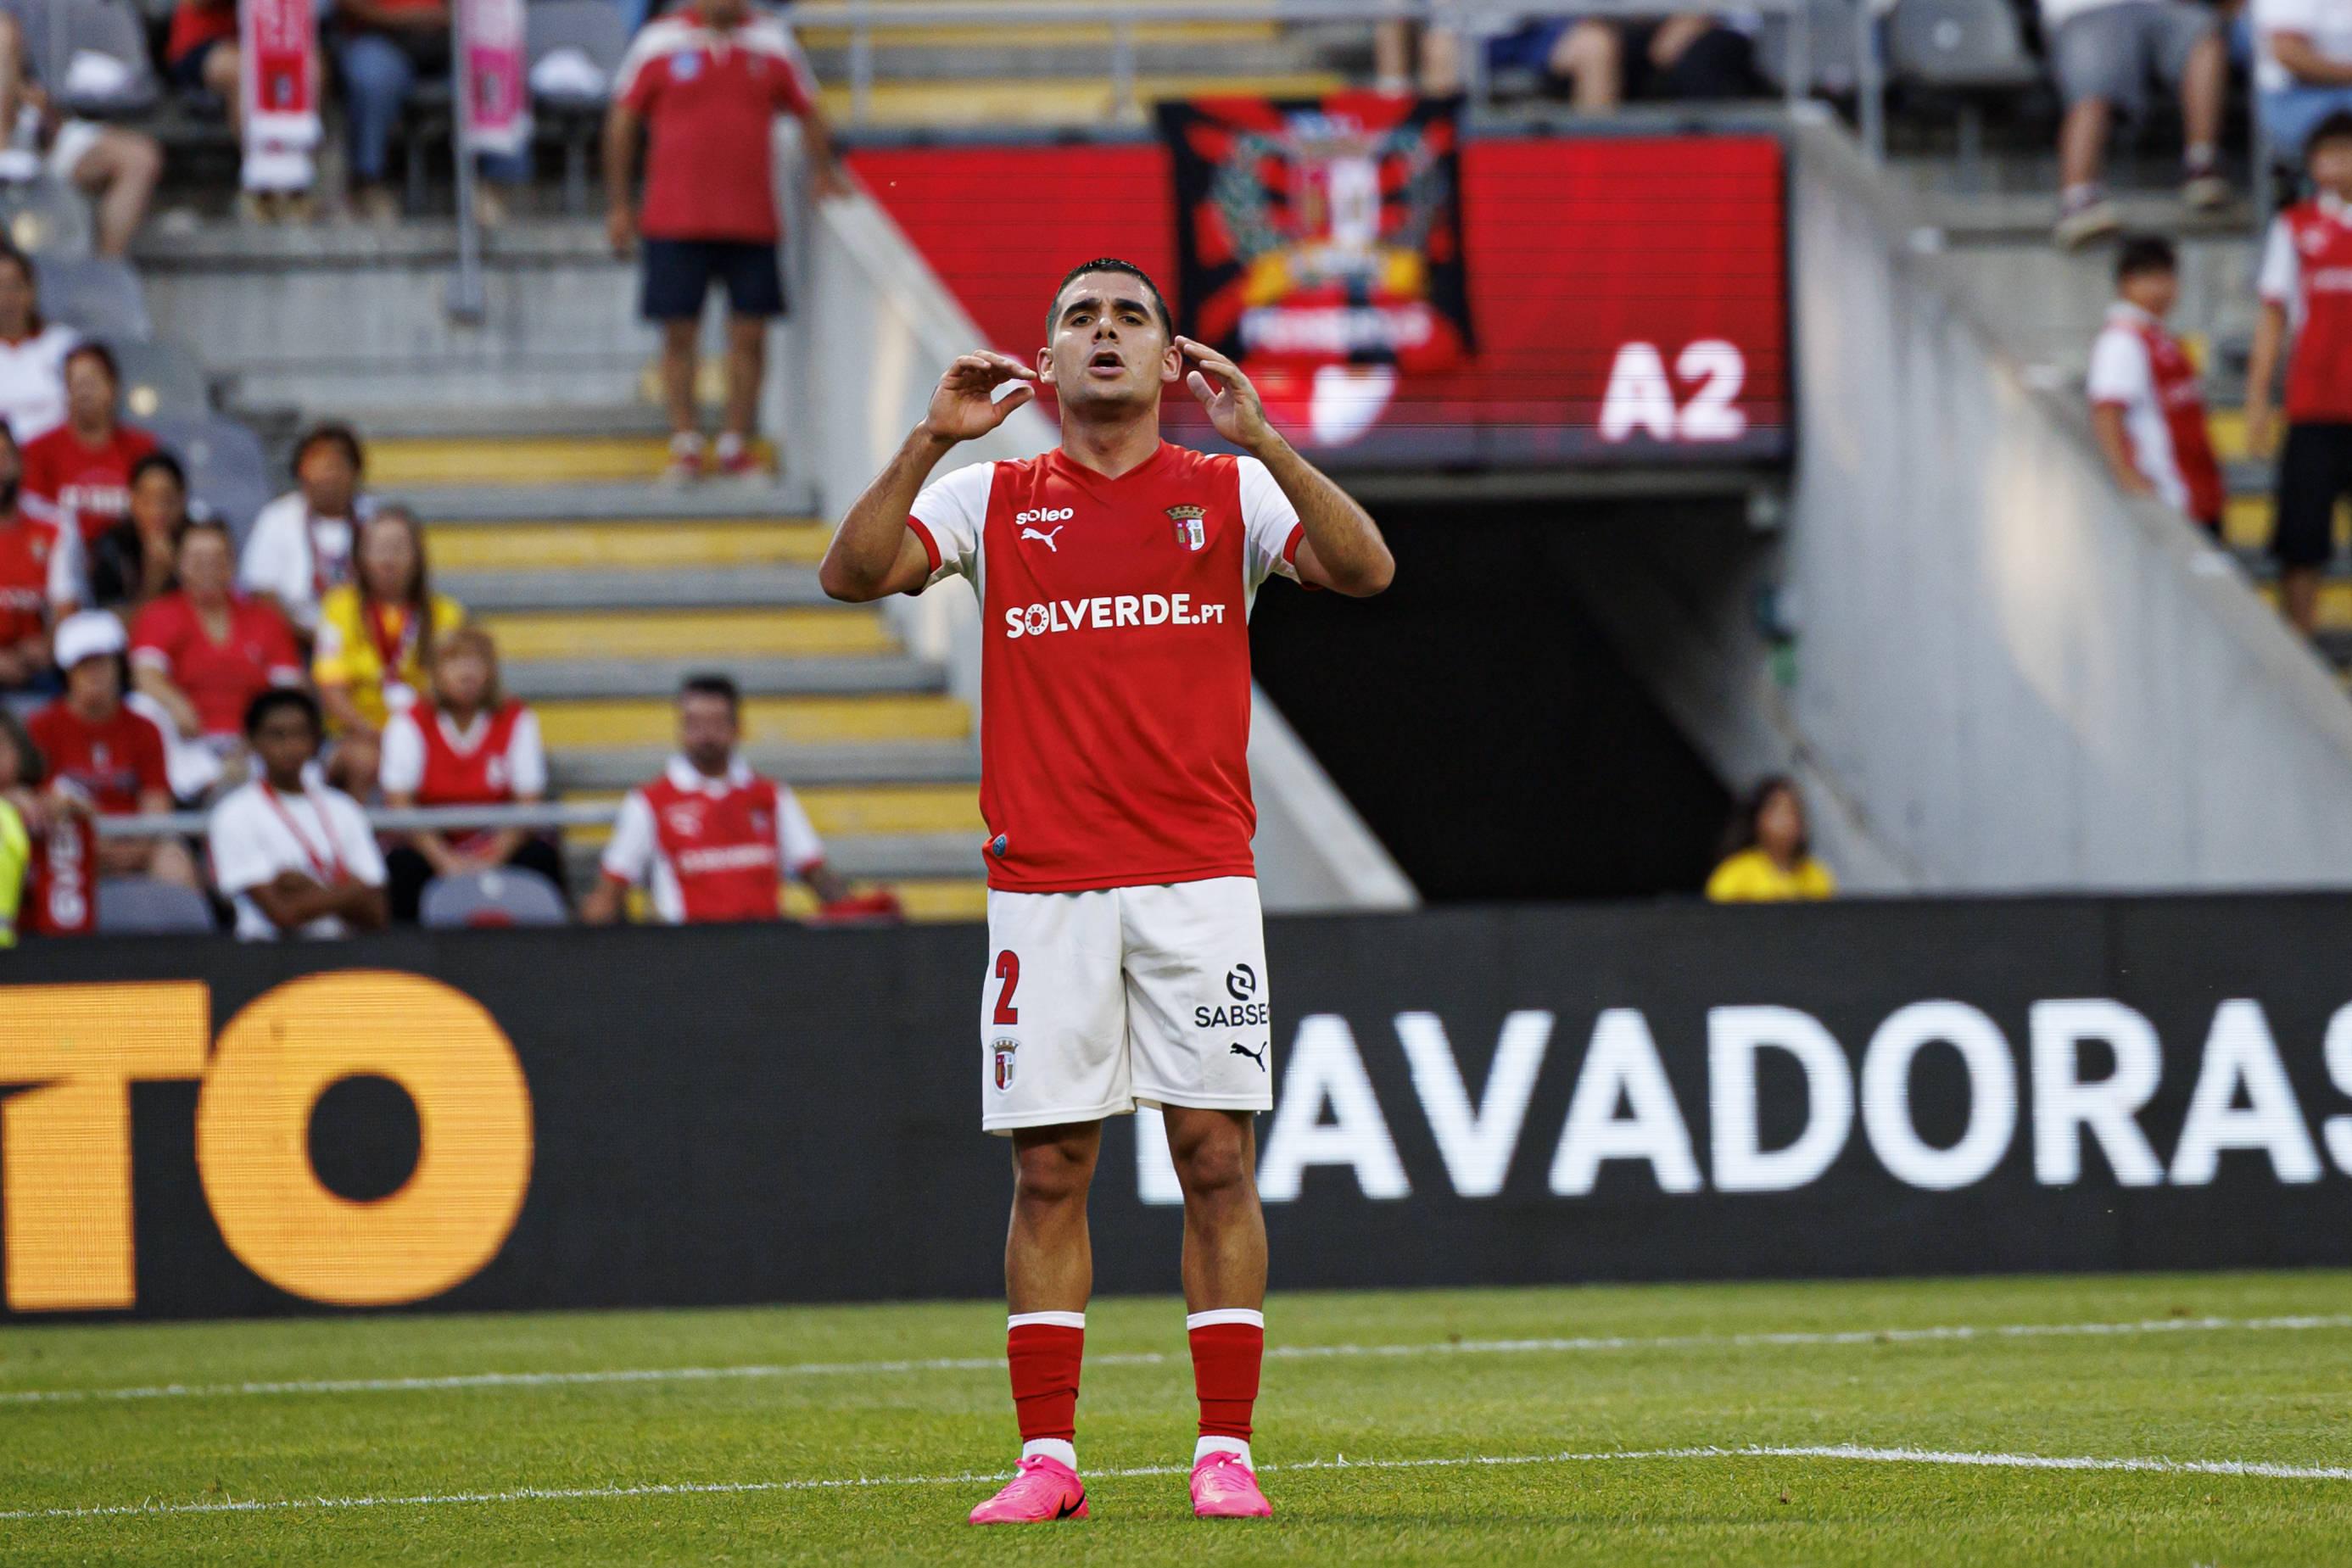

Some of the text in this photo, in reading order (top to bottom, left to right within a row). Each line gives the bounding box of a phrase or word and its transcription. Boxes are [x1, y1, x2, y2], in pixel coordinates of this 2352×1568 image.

[1600, 339, 1746, 441] A2
[1015, 507, 1074, 525] soleo
[1005, 593, 1226, 639] SOLVERDE.PT
[993, 950, 1020, 1025] 2
[1194, 1003, 1270, 1028] SABSE
[1136, 997, 2352, 1203] AVADORA
